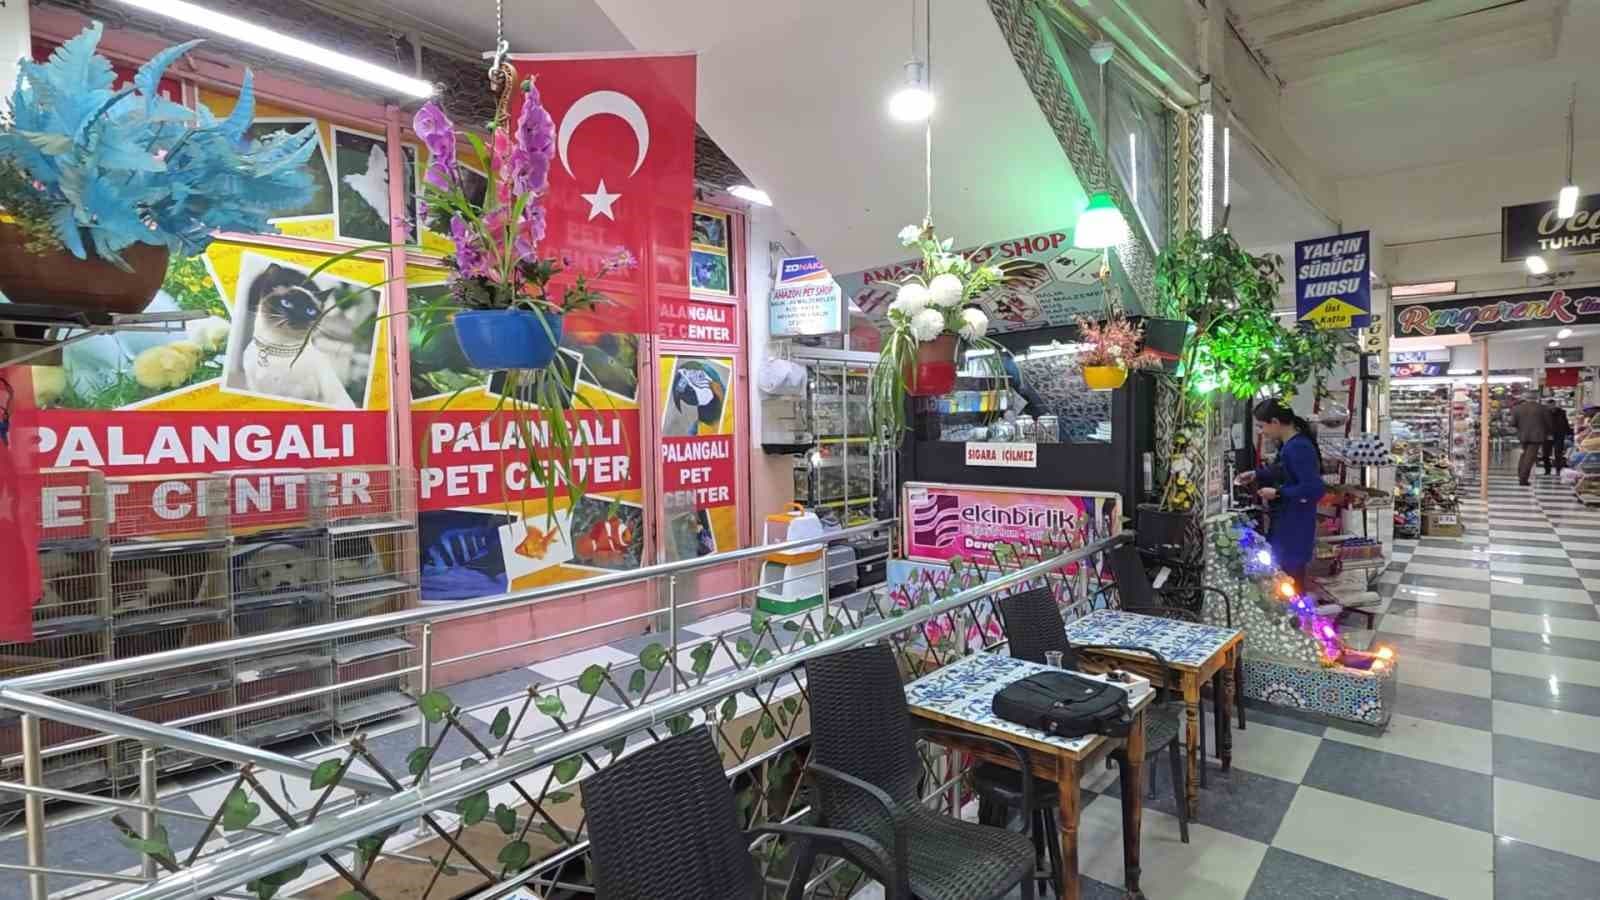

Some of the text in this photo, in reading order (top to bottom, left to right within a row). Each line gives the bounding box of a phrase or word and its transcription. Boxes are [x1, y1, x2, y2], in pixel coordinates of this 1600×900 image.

[1000, 232, 1067, 258] SHOP
[1302, 237, 1363, 260] YALÇIN
[1299, 253, 1366, 280] SÜRÜCÜ
[1304, 277, 1361, 298] KURSU
[659, 303, 726, 323] ALANGALI
[679, 323, 730, 341] CENTER
[661, 439, 729, 463] PALANGALI
[420, 463, 494, 498] PET
[680, 467, 712, 485] PET
